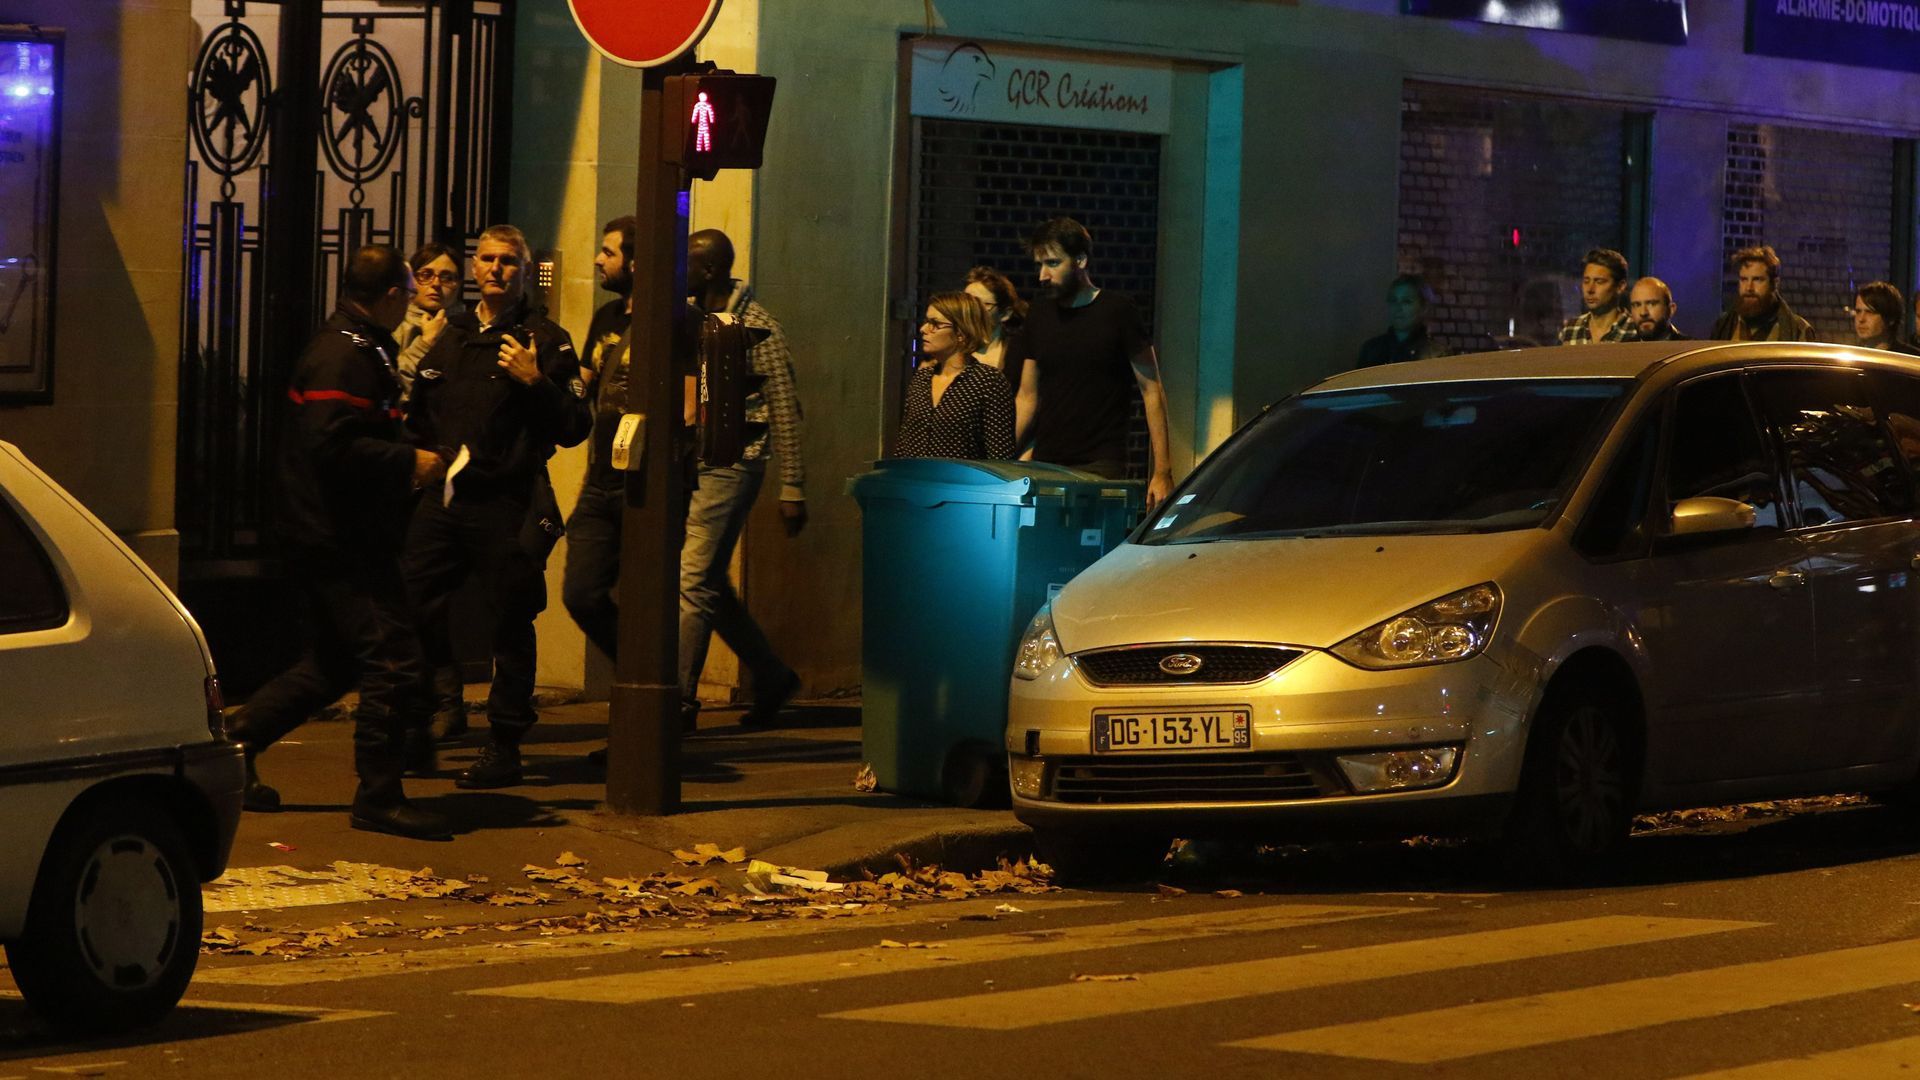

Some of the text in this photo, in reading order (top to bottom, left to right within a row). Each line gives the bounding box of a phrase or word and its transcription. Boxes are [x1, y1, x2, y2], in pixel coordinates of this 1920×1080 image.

[1007, 69, 1149, 115] GCR Créations
[1234, 730, 1248, 744] 95
